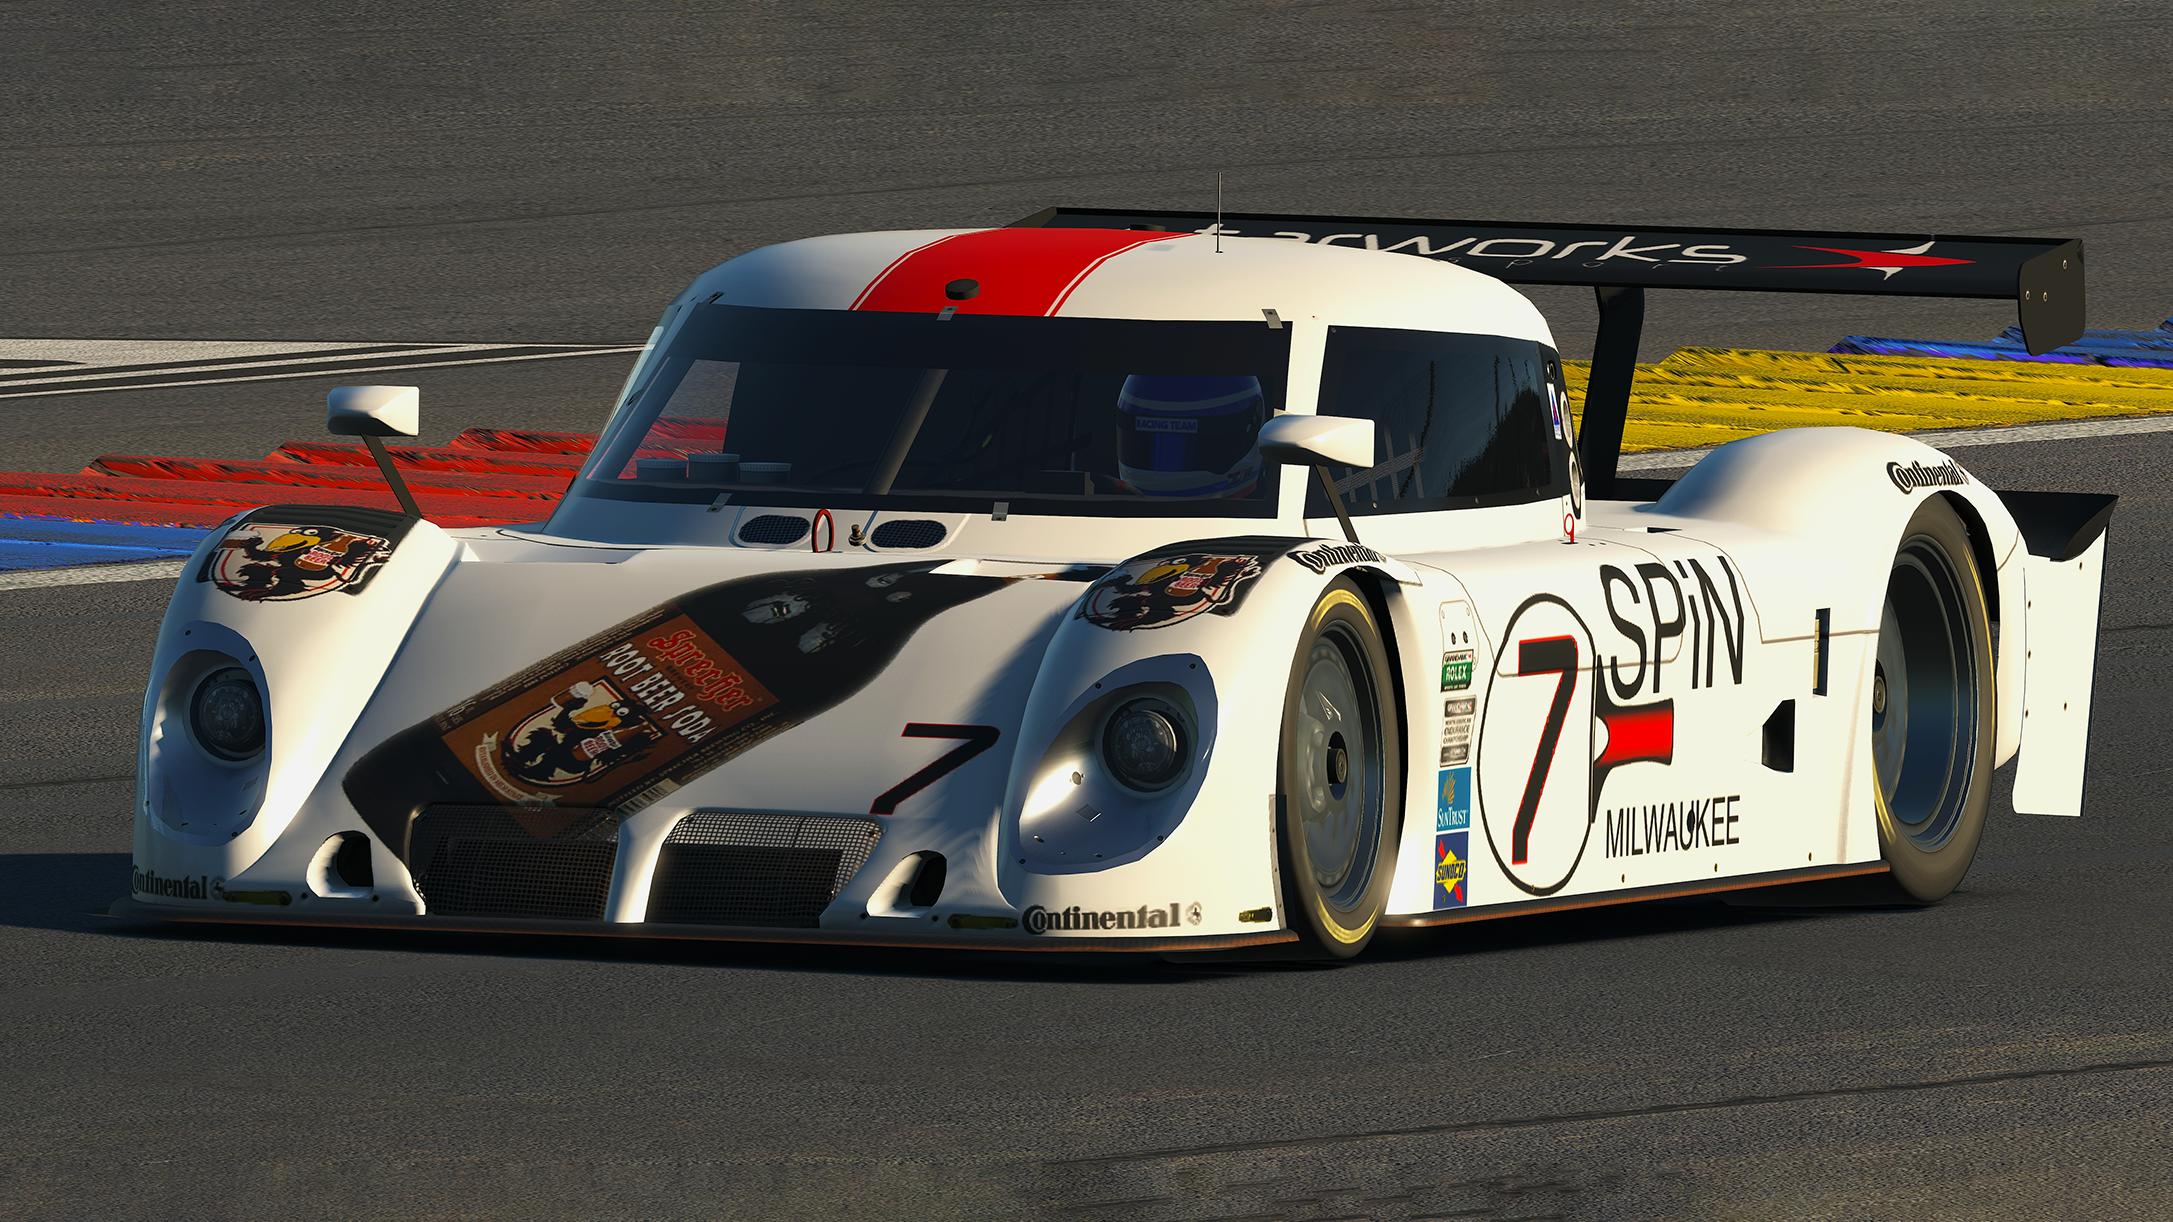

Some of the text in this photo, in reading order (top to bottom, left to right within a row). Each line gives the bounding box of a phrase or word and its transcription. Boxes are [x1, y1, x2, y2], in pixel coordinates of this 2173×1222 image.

[1136, 417, 1197, 431] RACING TEAM
[1886, 459, 1964, 495] Continental
[1286, 543, 1381, 575] Continental
[647, 629, 754, 713] Sprecher
[1446, 665, 1467, 682] ROLEX
[599, 642, 652, 683] ROOT
[629, 672, 686, 719] BEER
[665, 704, 720, 745] SODA
[1511, 633, 1579, 866] 7
[868, 722, 1001, 816] 7
[1605, 795, 1741, 859] MILWAUKEE
[131, 864, 208, 899] Continental
[1436, 862, 1465, 882] SUNOCO
[1022, 902, 1181, 935] Continental
